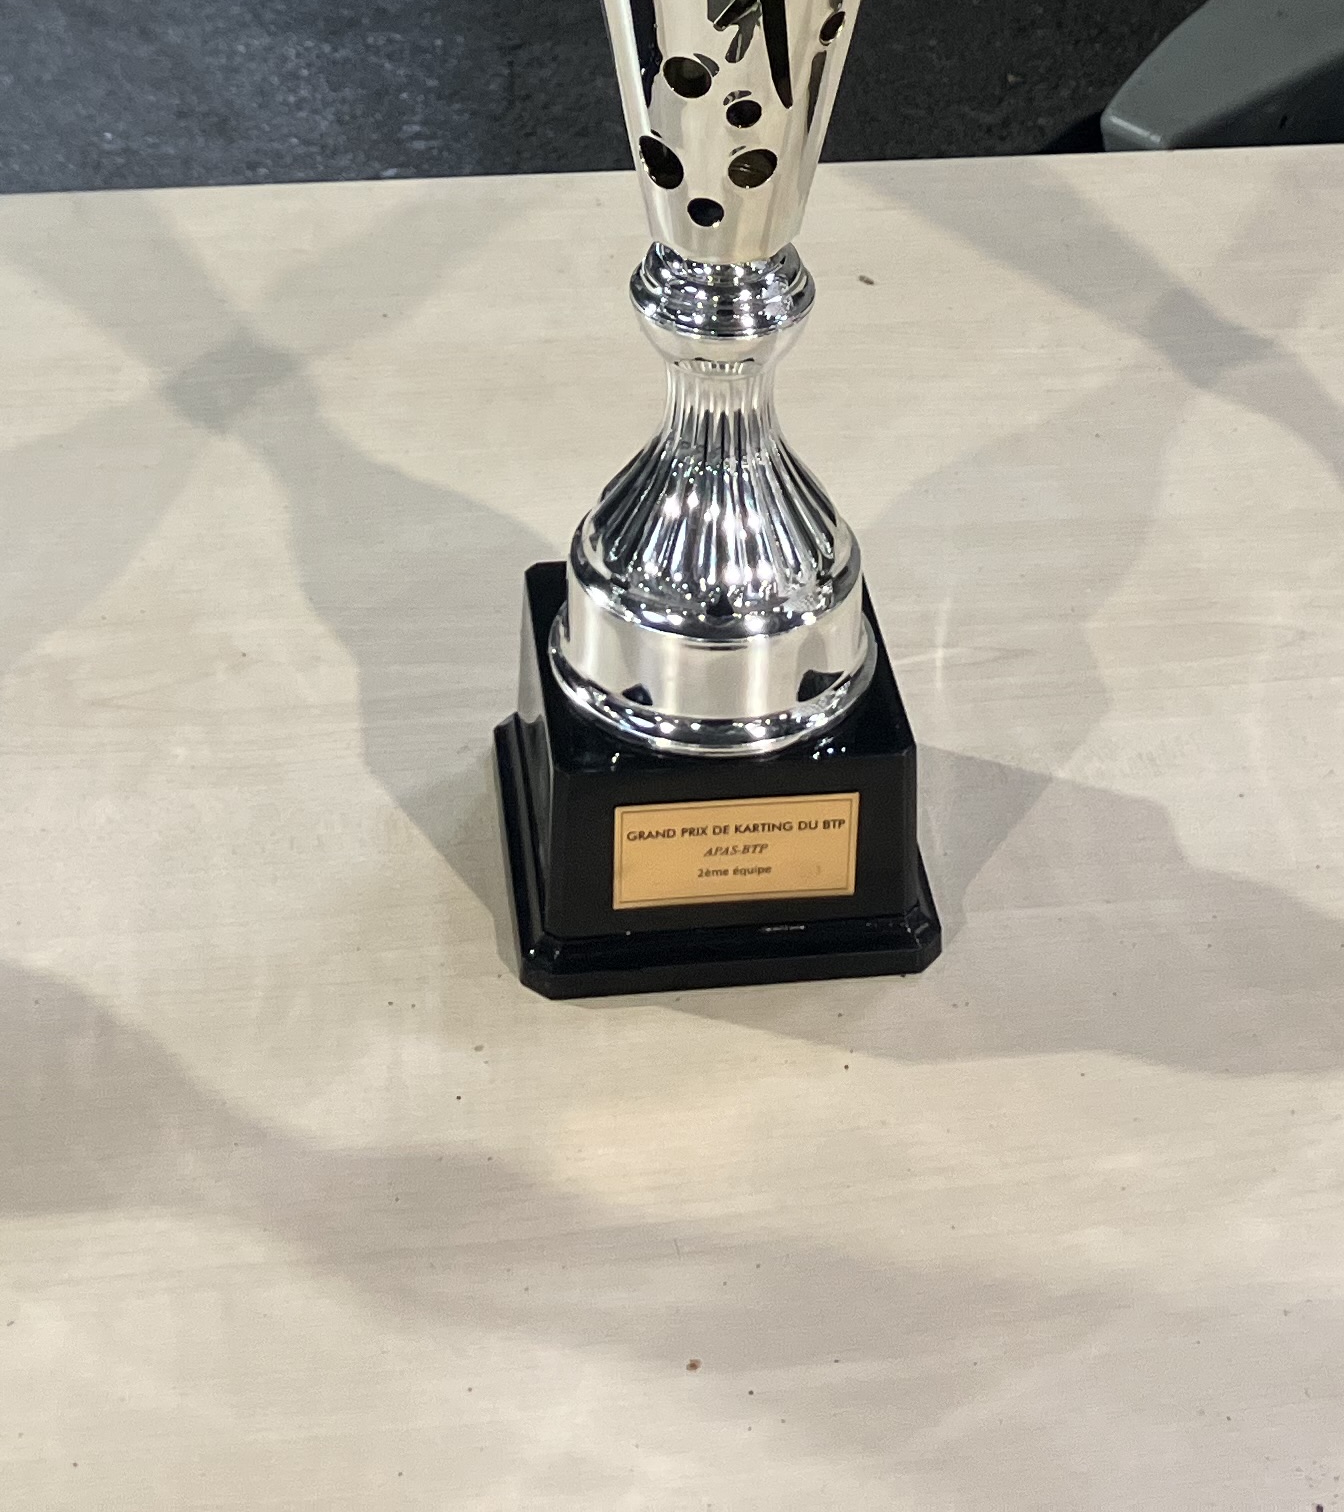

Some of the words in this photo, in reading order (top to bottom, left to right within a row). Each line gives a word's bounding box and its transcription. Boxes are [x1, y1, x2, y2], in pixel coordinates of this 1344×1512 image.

[626, 827, 677, 842] GRAND
[680, 825, 709, 838] PRIX
[712, 824, 730, 836] DE
[734, 820, 794, 835] KARTING
[798, 819, 819, 831] DU
[822, 818, 846, 830] BTP
[703, 843, 769, 858] APAS-BTP
[697, 865, 730, 879] 2ème
[732, 864, 772, 878] équipe
